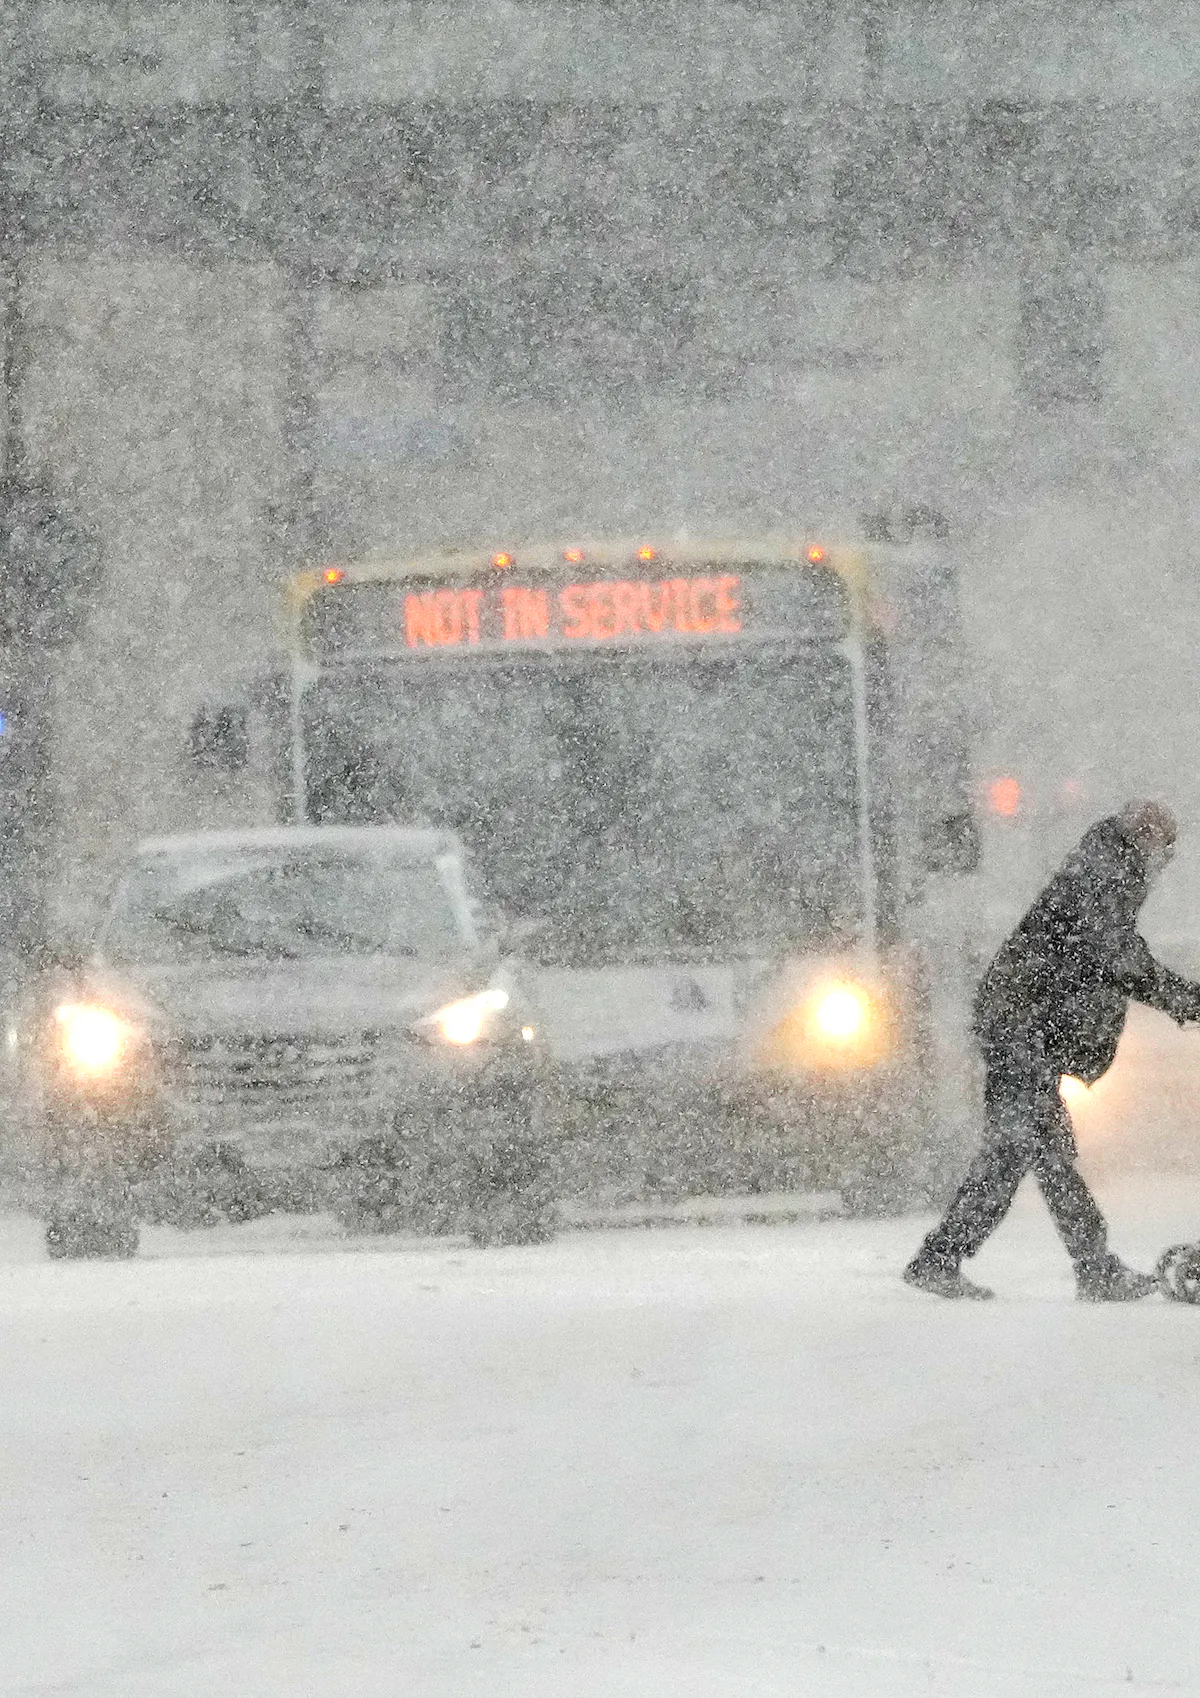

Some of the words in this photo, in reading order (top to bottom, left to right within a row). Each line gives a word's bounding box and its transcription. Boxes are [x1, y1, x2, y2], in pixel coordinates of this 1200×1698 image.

[404, 588, 484, 648] NOT
[501, 586, 549, 640] IN
[559, 575, 742, 639] SERVICE
